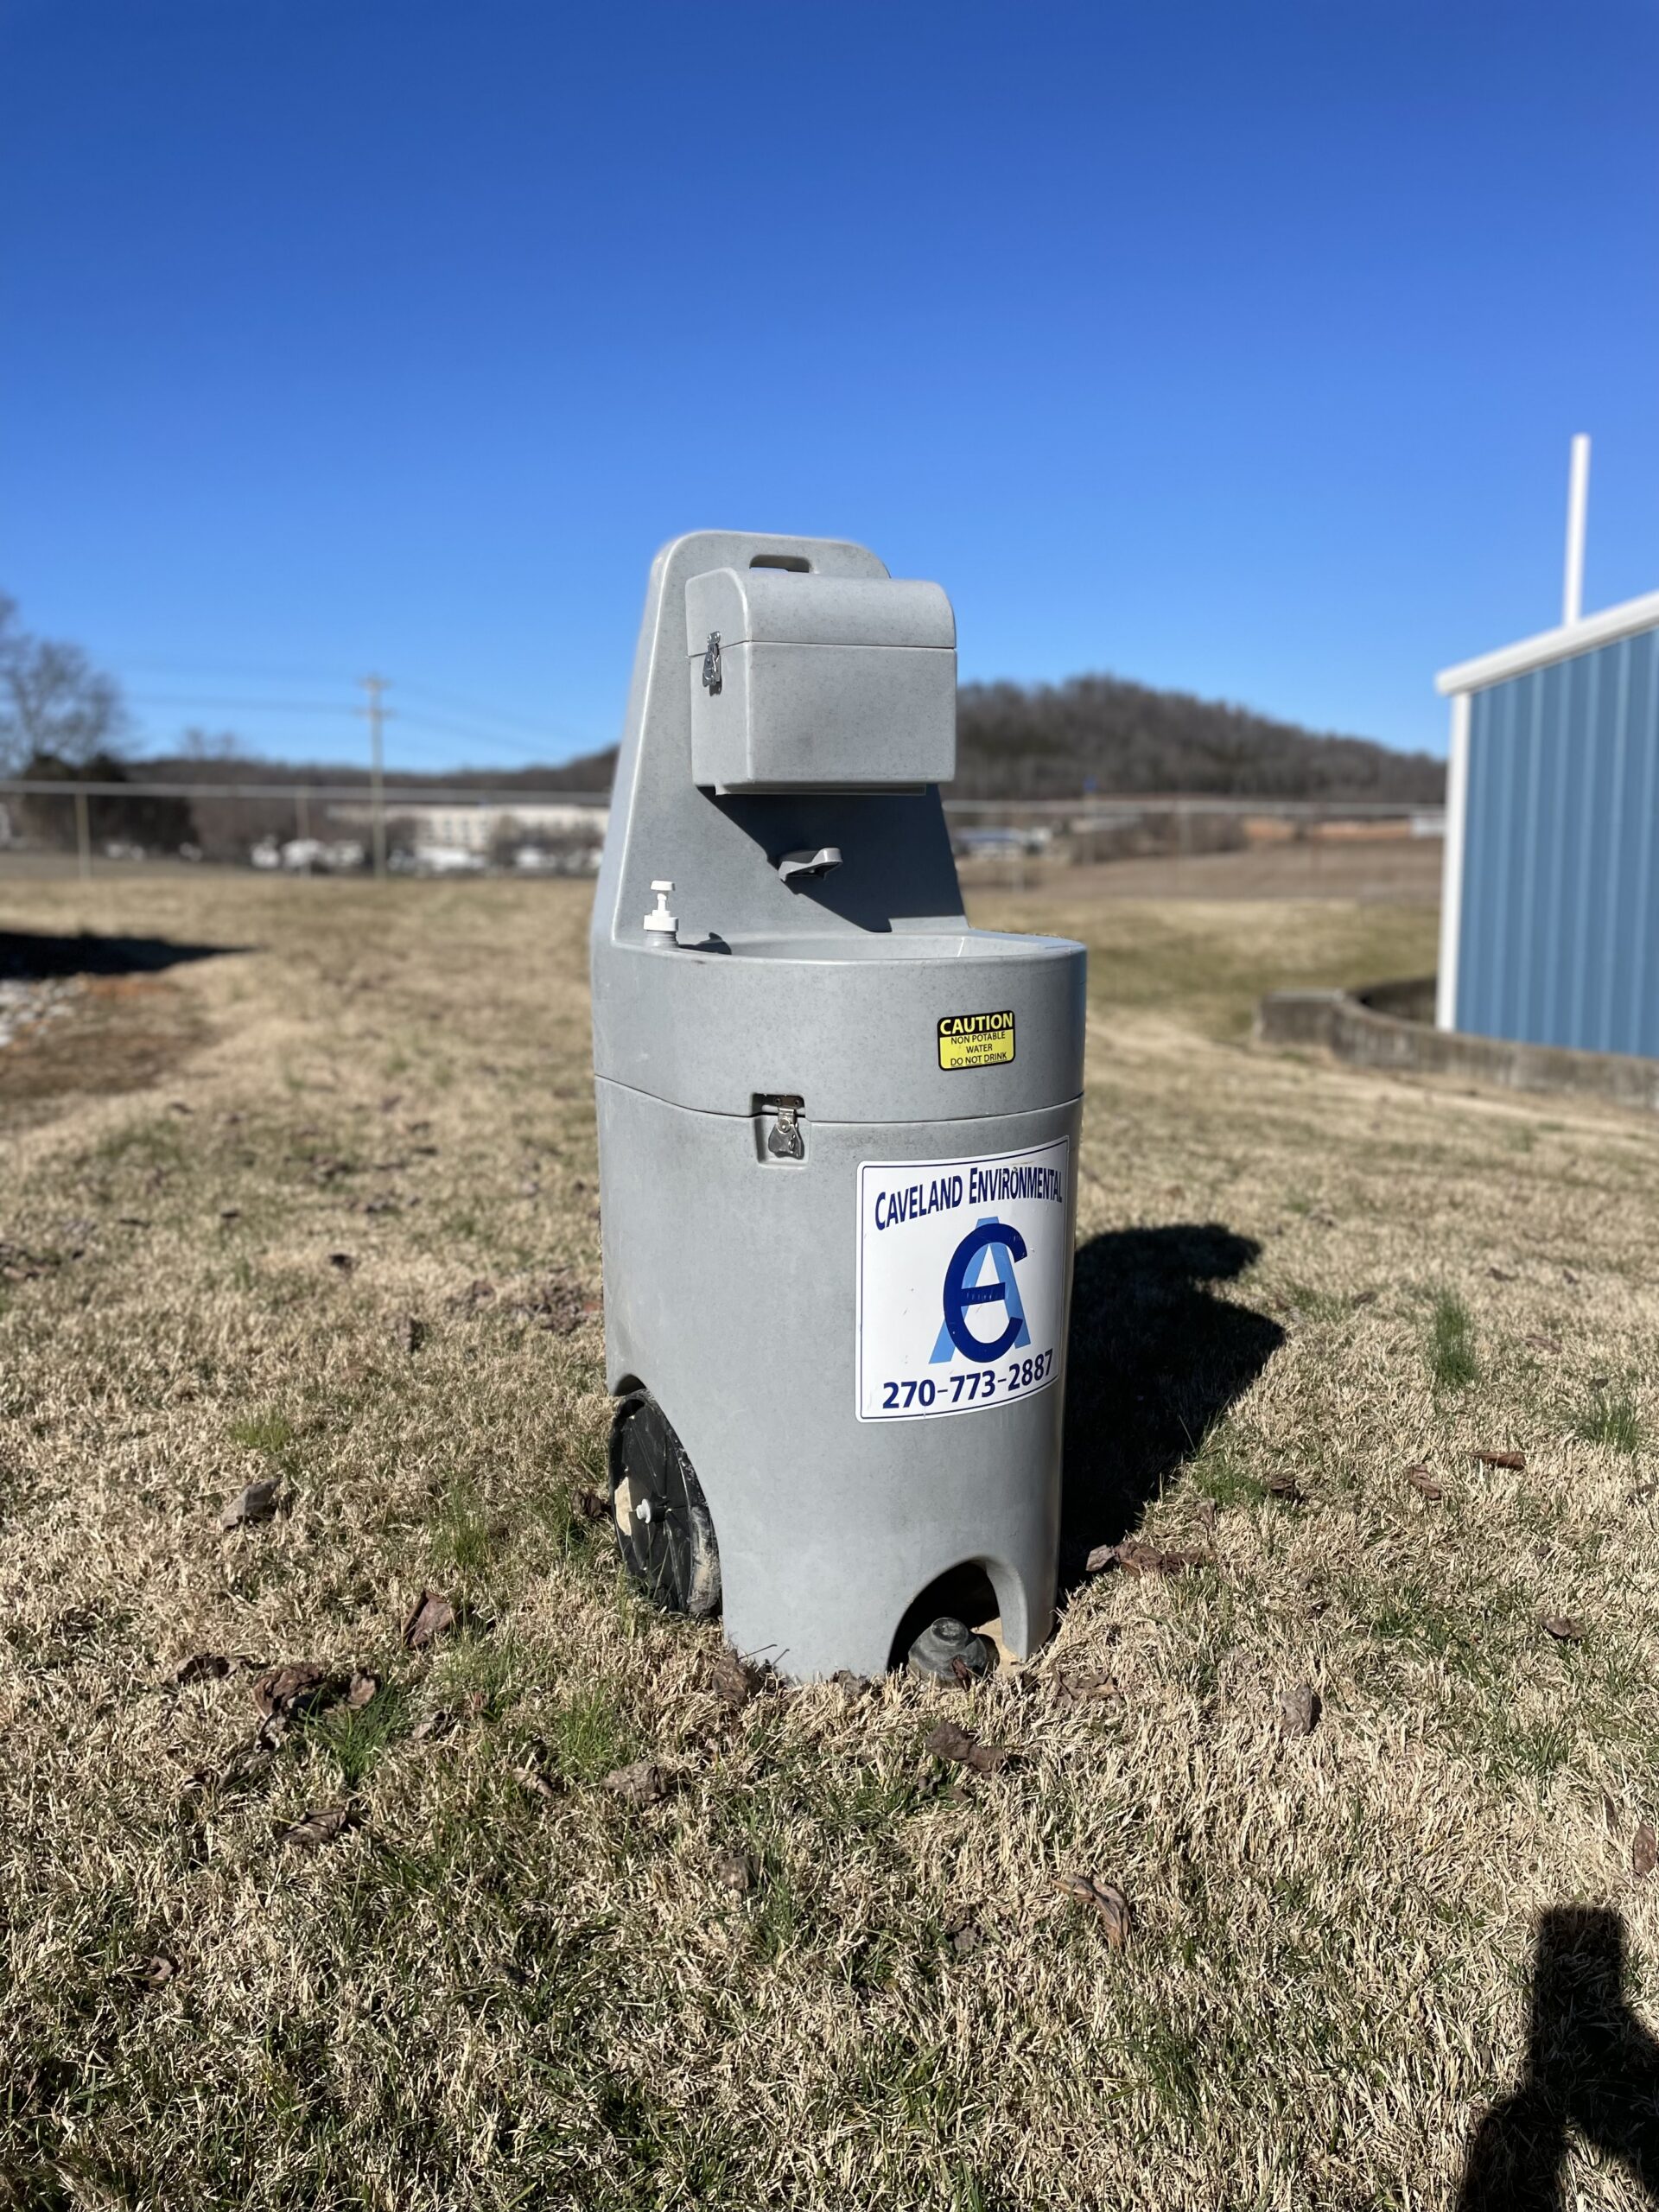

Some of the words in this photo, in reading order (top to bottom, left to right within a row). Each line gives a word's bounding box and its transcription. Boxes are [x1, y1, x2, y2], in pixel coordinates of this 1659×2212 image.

[940, 1012, 1013, 1035] CAUTION
[950, 1035, 970, 1045] NON
[972, 1031, 1006, 1043] POTABLE
[966, 1043, 993, 1053] WATER
[950, 1057, 963, 1066] DO
[965, 1055, 982, 1065] NOT
[984, 1052, 1007, 1062] DRINK
[874, 1174, 963, 1230] CAVELAND
[969, 1166, 1063, 1205] ENVIRONMENTAL
[882, 1348, 1053, 1409] 270-773-2887
